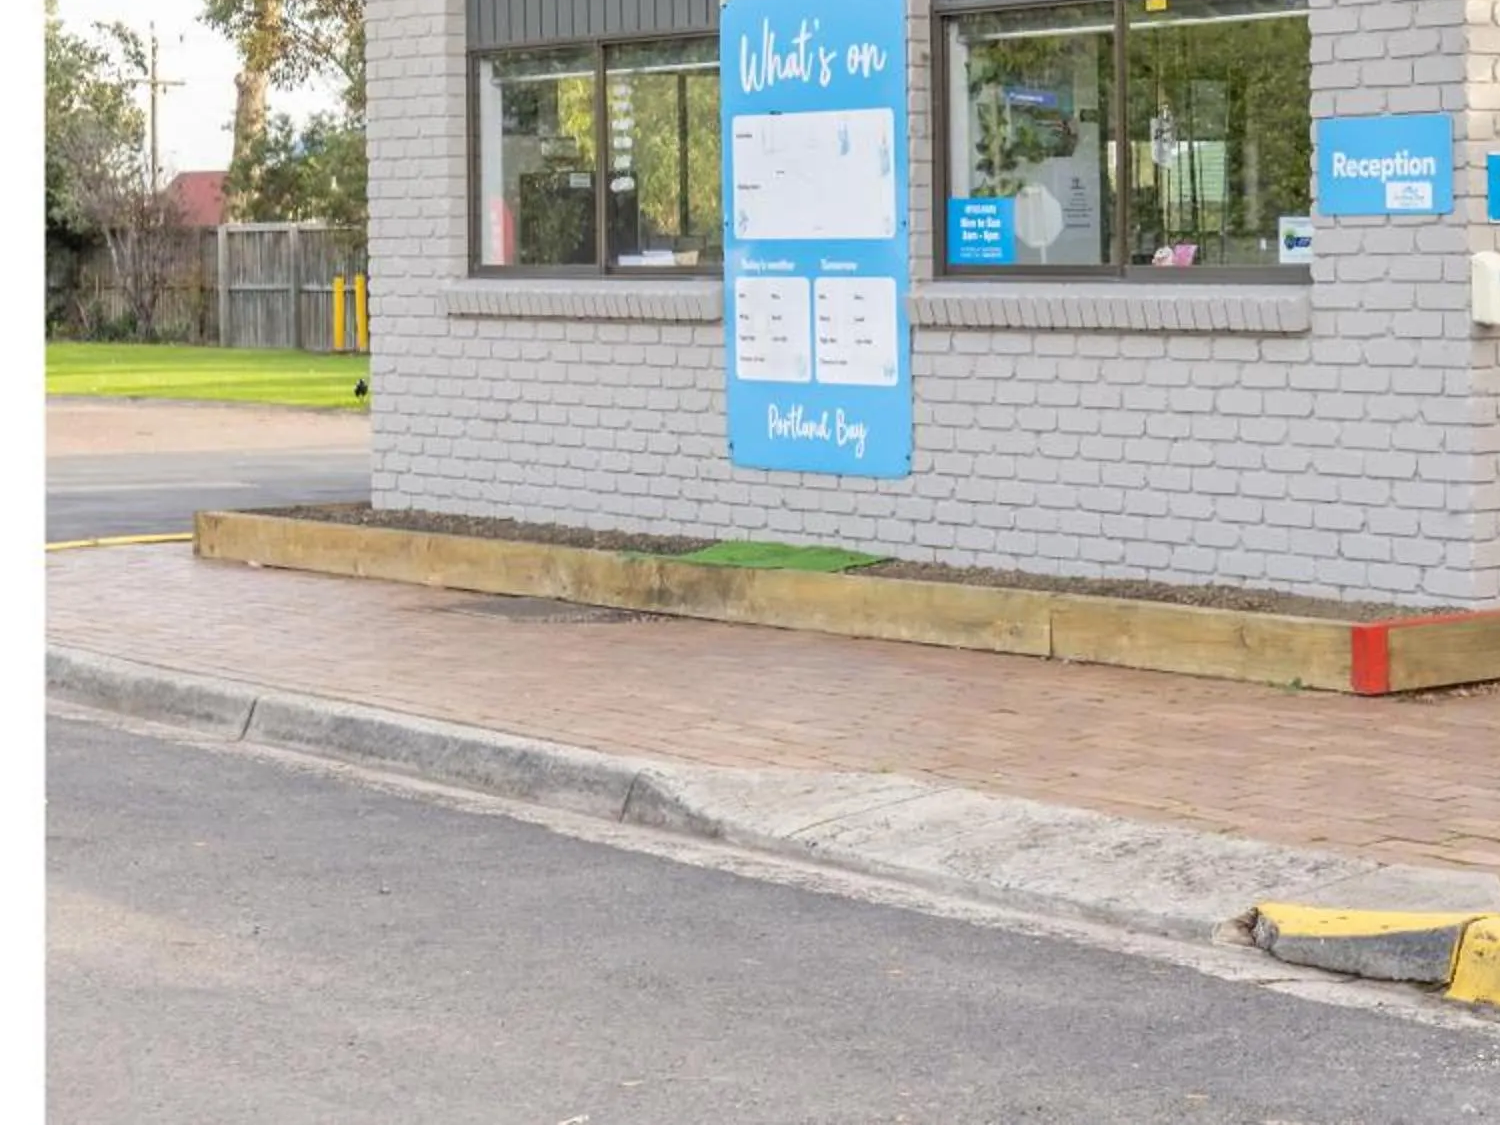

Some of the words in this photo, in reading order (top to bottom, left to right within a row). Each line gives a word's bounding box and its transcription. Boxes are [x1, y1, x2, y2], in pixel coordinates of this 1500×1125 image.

[740, 17, 837, 94] What's
[847, 42, 887, 78] on
[1333, 150, 1436, 183] Reception
[768, 403, 832, 441] Portland
[836, 407, 869, 459] Bay
